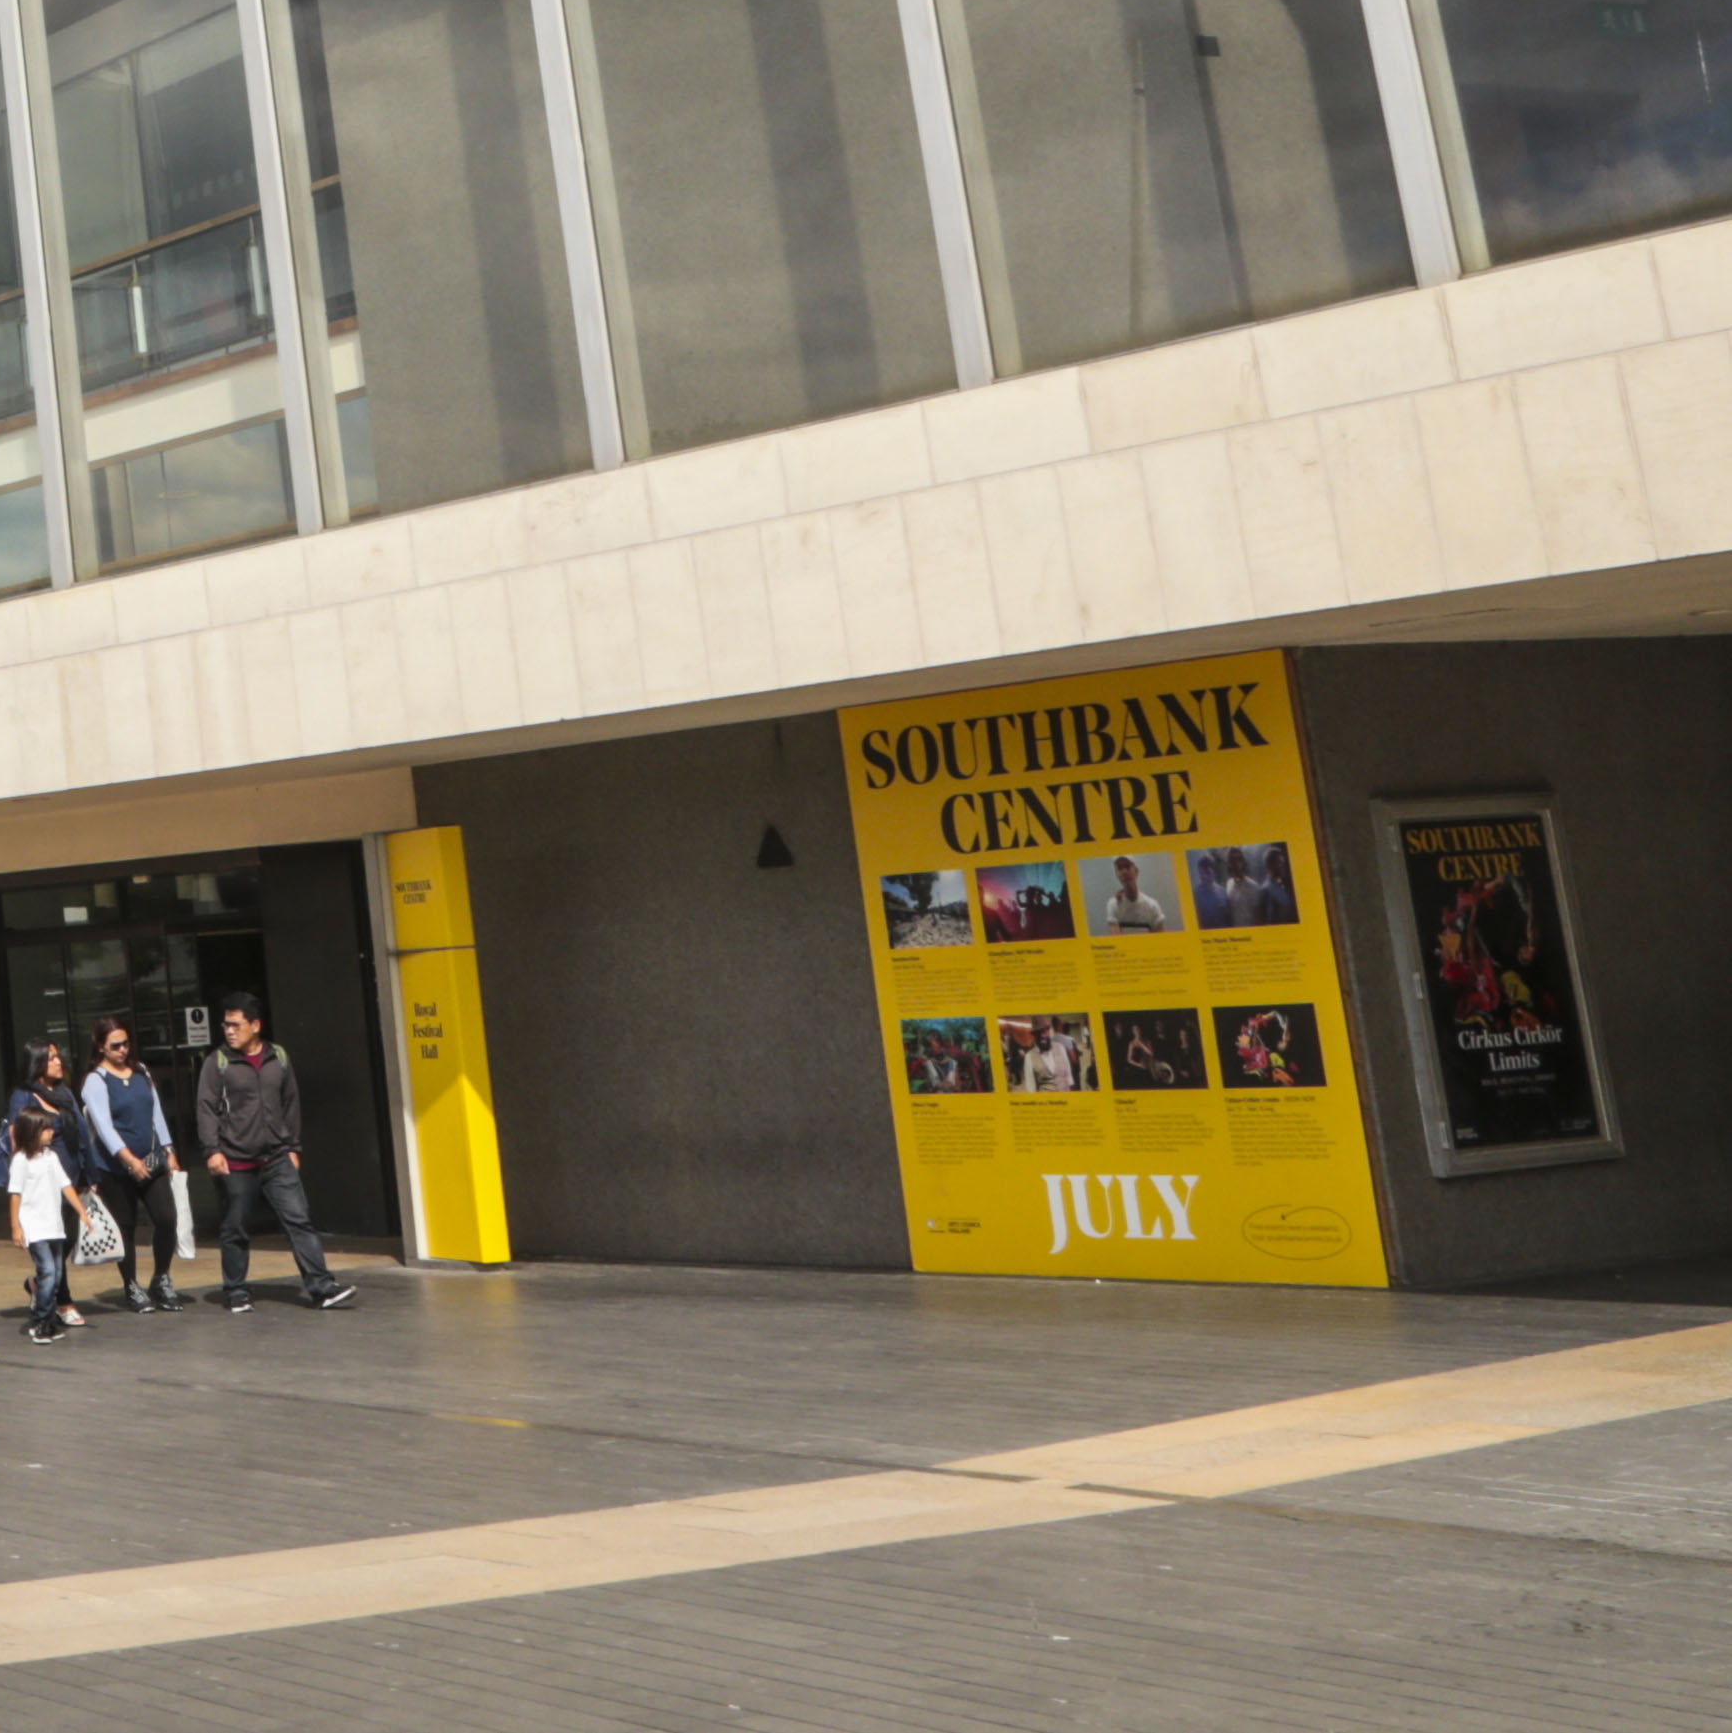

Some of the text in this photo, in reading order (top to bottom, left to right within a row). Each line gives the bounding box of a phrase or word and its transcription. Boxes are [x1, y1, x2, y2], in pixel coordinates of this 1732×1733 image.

[861, 682, 1270, 790] SOUTHBANK
[940, 770, 1199, 855] CENTRE
[1406, 822, 1542, 854] SOUTHBANK
[1438, 853, 1524, 881] CENTRE
[414, 1002, 438, 1019] Royal
[412, 1022, 444, 1038] Festival
[1457, 1029, 1513, 1050] Cirkus
[421, 1044, 439, 1060] Hall
[1488, 1051, 1541, 1072] Limits
[1041, 1174, 1201, 1255] JULY
